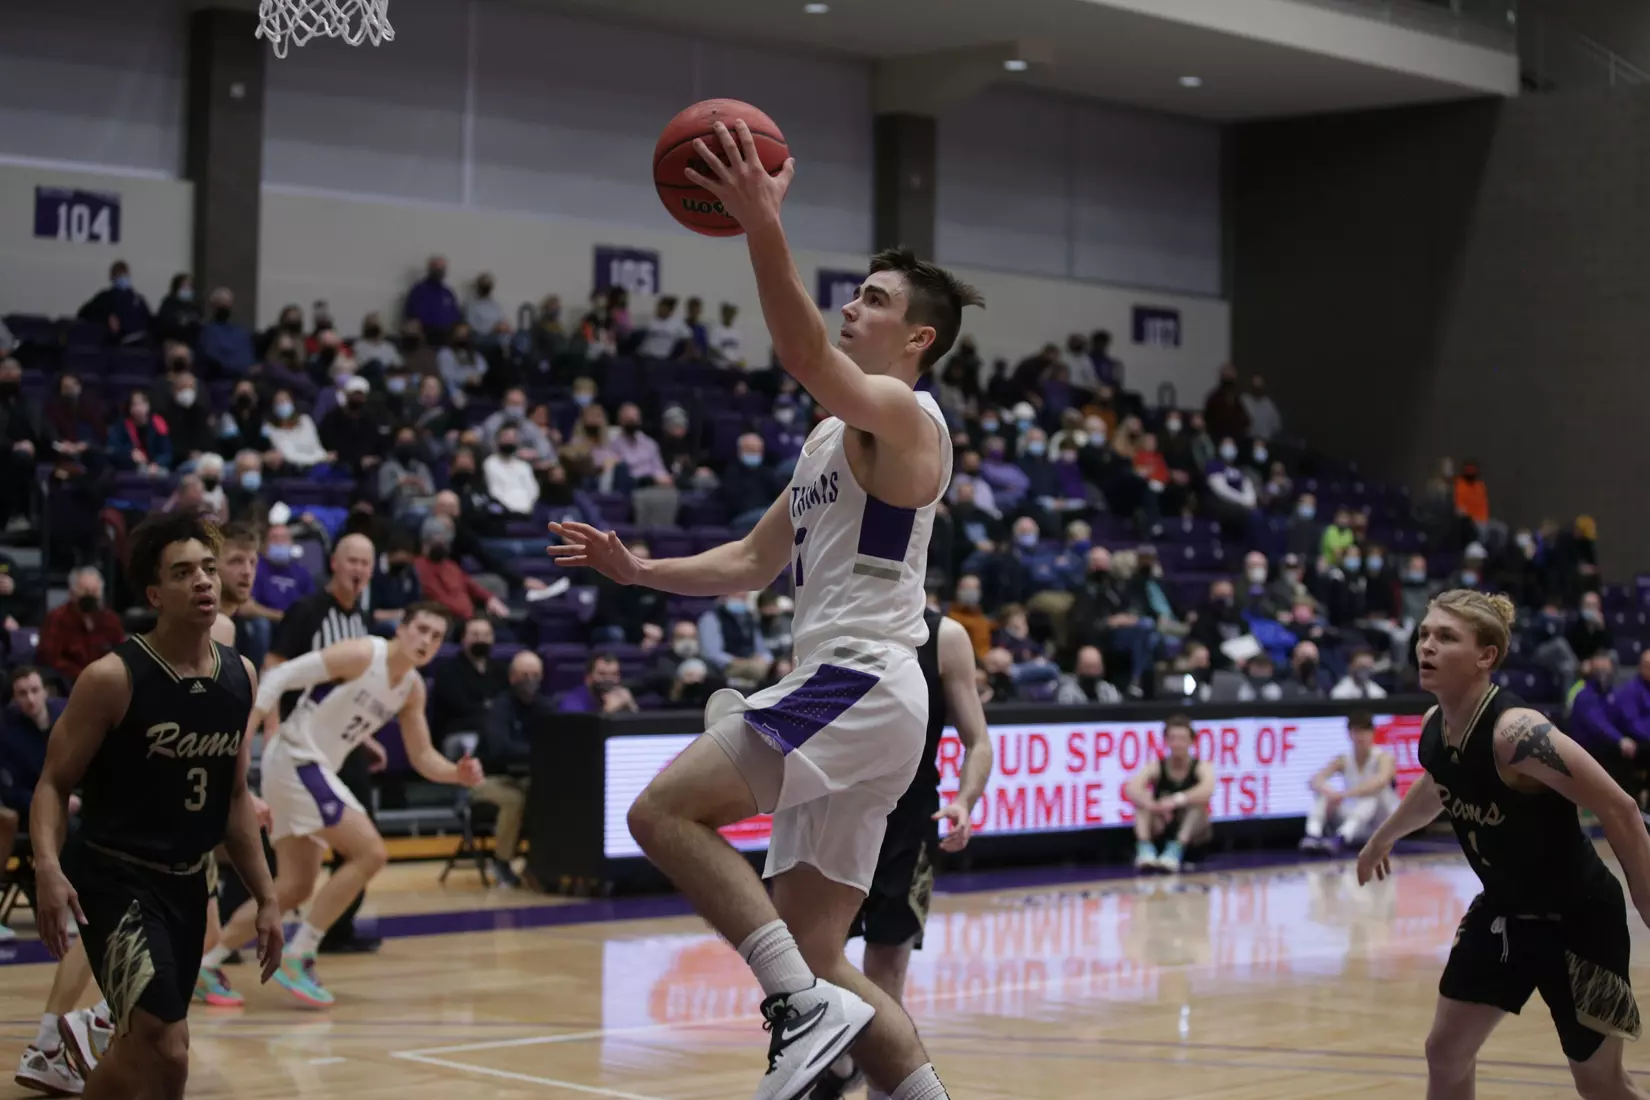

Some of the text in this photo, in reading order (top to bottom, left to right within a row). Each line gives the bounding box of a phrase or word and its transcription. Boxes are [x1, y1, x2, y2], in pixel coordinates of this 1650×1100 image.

[57, 201, 111, 245] 104
[146, 721, 241, 760] Rams
[1067, 727, 1240, 773] SPONOR
[1256, 725, 1298, 767] OF
[184, 767, 208, 812] 3
